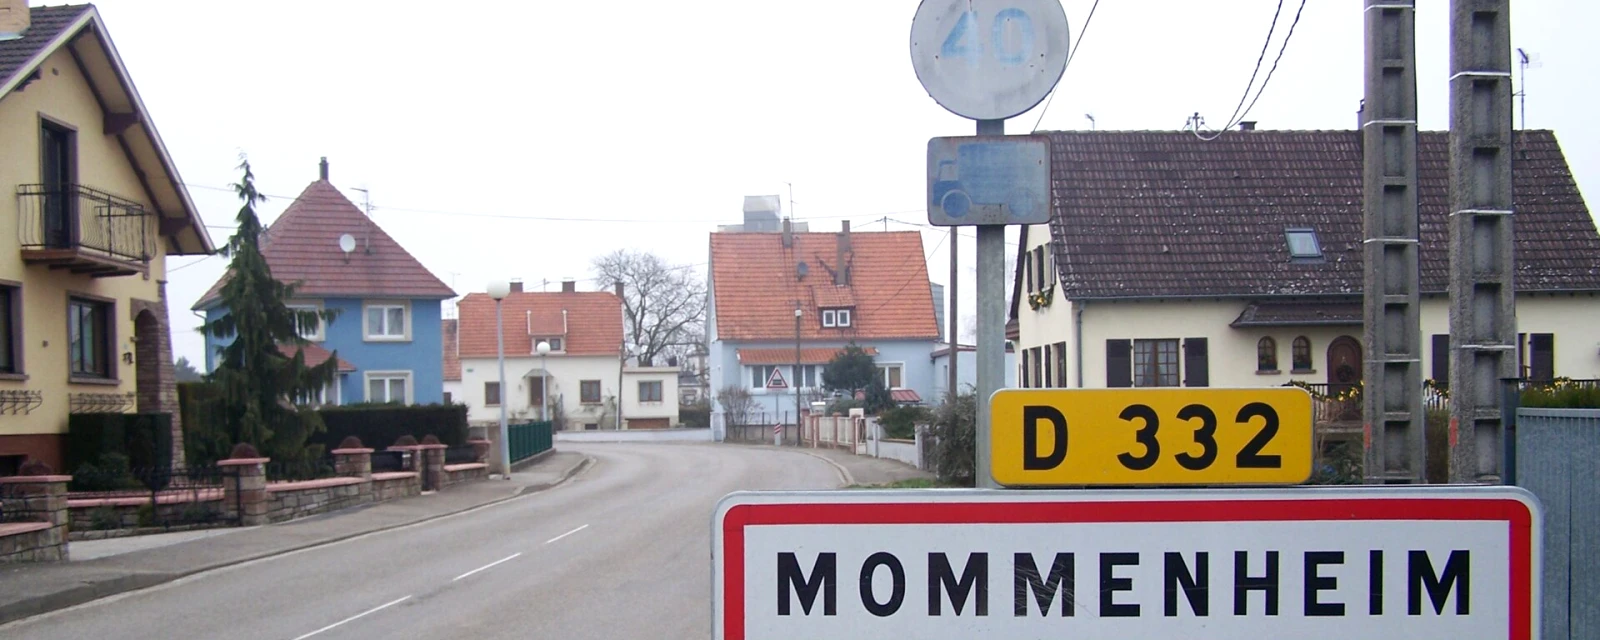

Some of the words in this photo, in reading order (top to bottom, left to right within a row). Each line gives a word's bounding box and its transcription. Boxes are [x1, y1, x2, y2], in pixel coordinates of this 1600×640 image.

[940, 7, 1034, 68] 40
[1023, 405, 1069, 471] D
[1116, 402, 1282, 471] 332
[777, 549, 1470, 618] MOMMENHEIM
